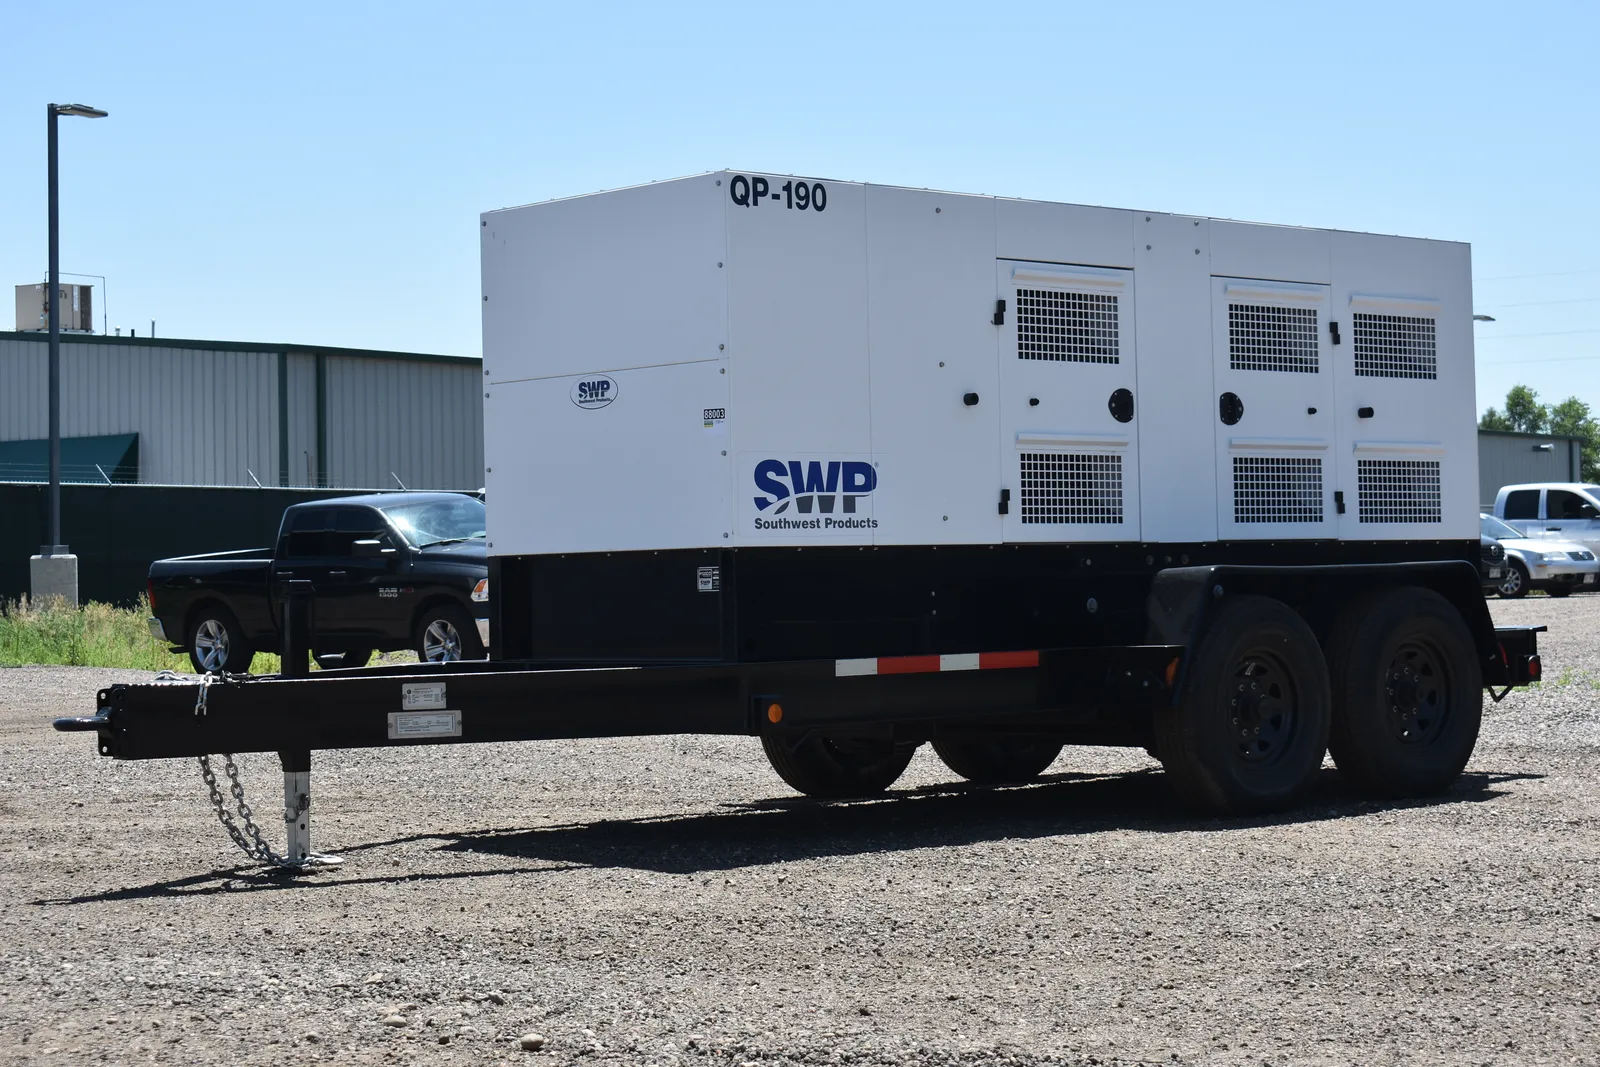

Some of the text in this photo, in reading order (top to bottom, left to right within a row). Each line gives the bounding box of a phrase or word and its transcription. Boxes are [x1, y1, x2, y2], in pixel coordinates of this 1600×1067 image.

[730, 175, 827, 211] QP-190
[579, 380, 610, 398] SWP
[704, 409, 725, 419] 88003
[754, 459, 878, 515] SWP
[754, 517, 878, 529] Southwest Products
